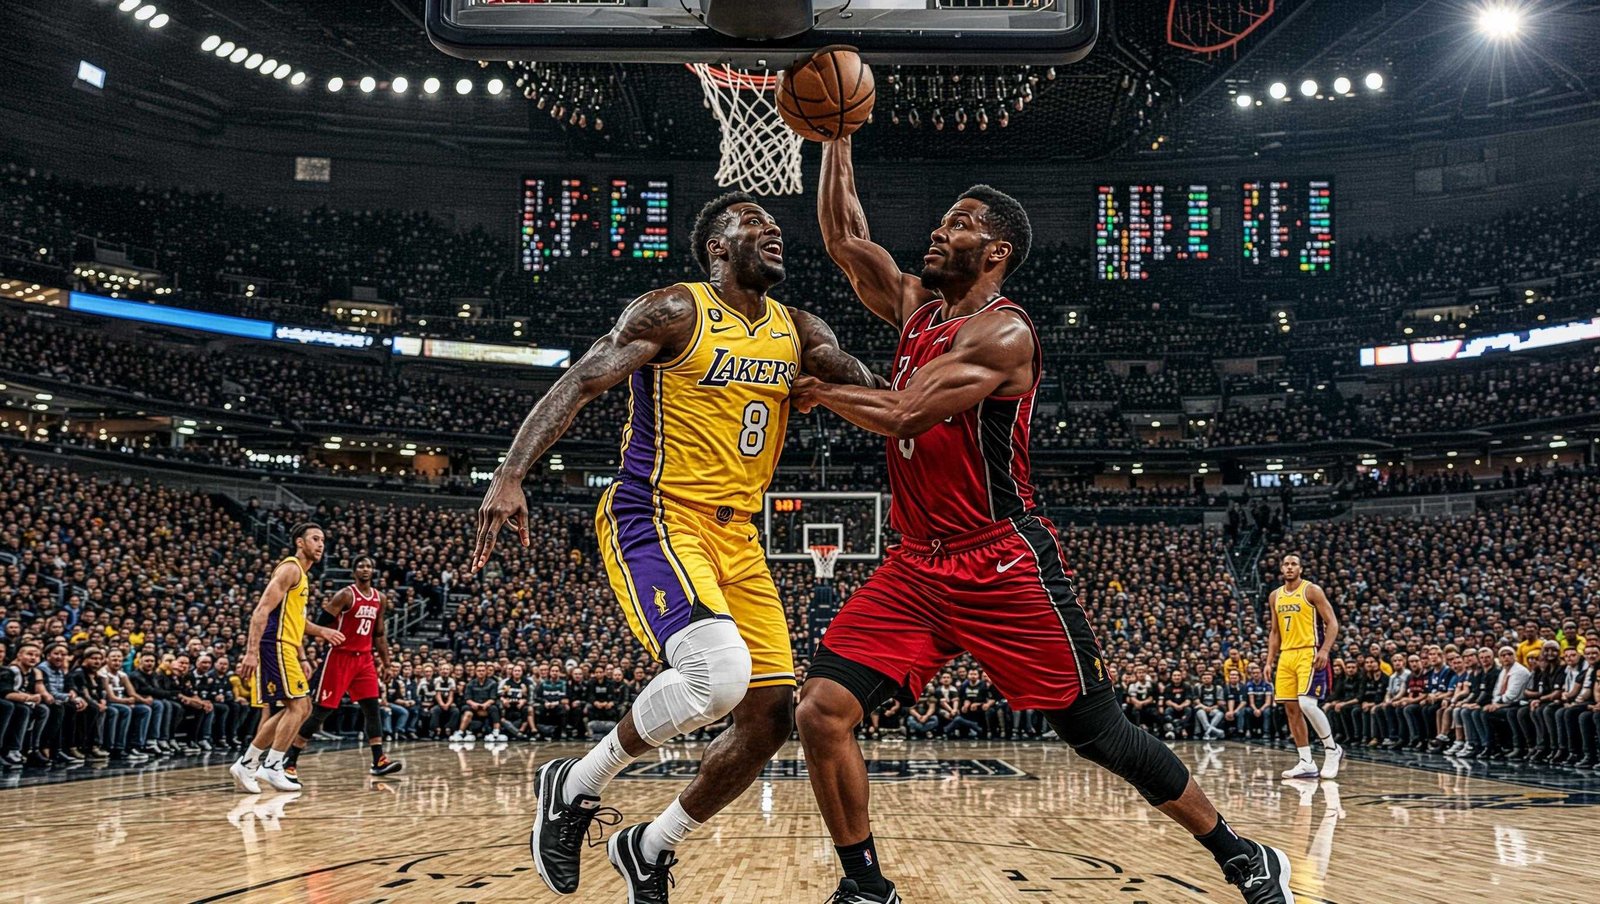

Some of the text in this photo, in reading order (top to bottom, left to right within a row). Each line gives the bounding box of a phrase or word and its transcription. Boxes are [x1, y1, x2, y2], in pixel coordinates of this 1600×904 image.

[697, 347, 797, 389] LAKERS
[737, 399, 770, 458] 8
[1283, 615, 1292, 632] 7
